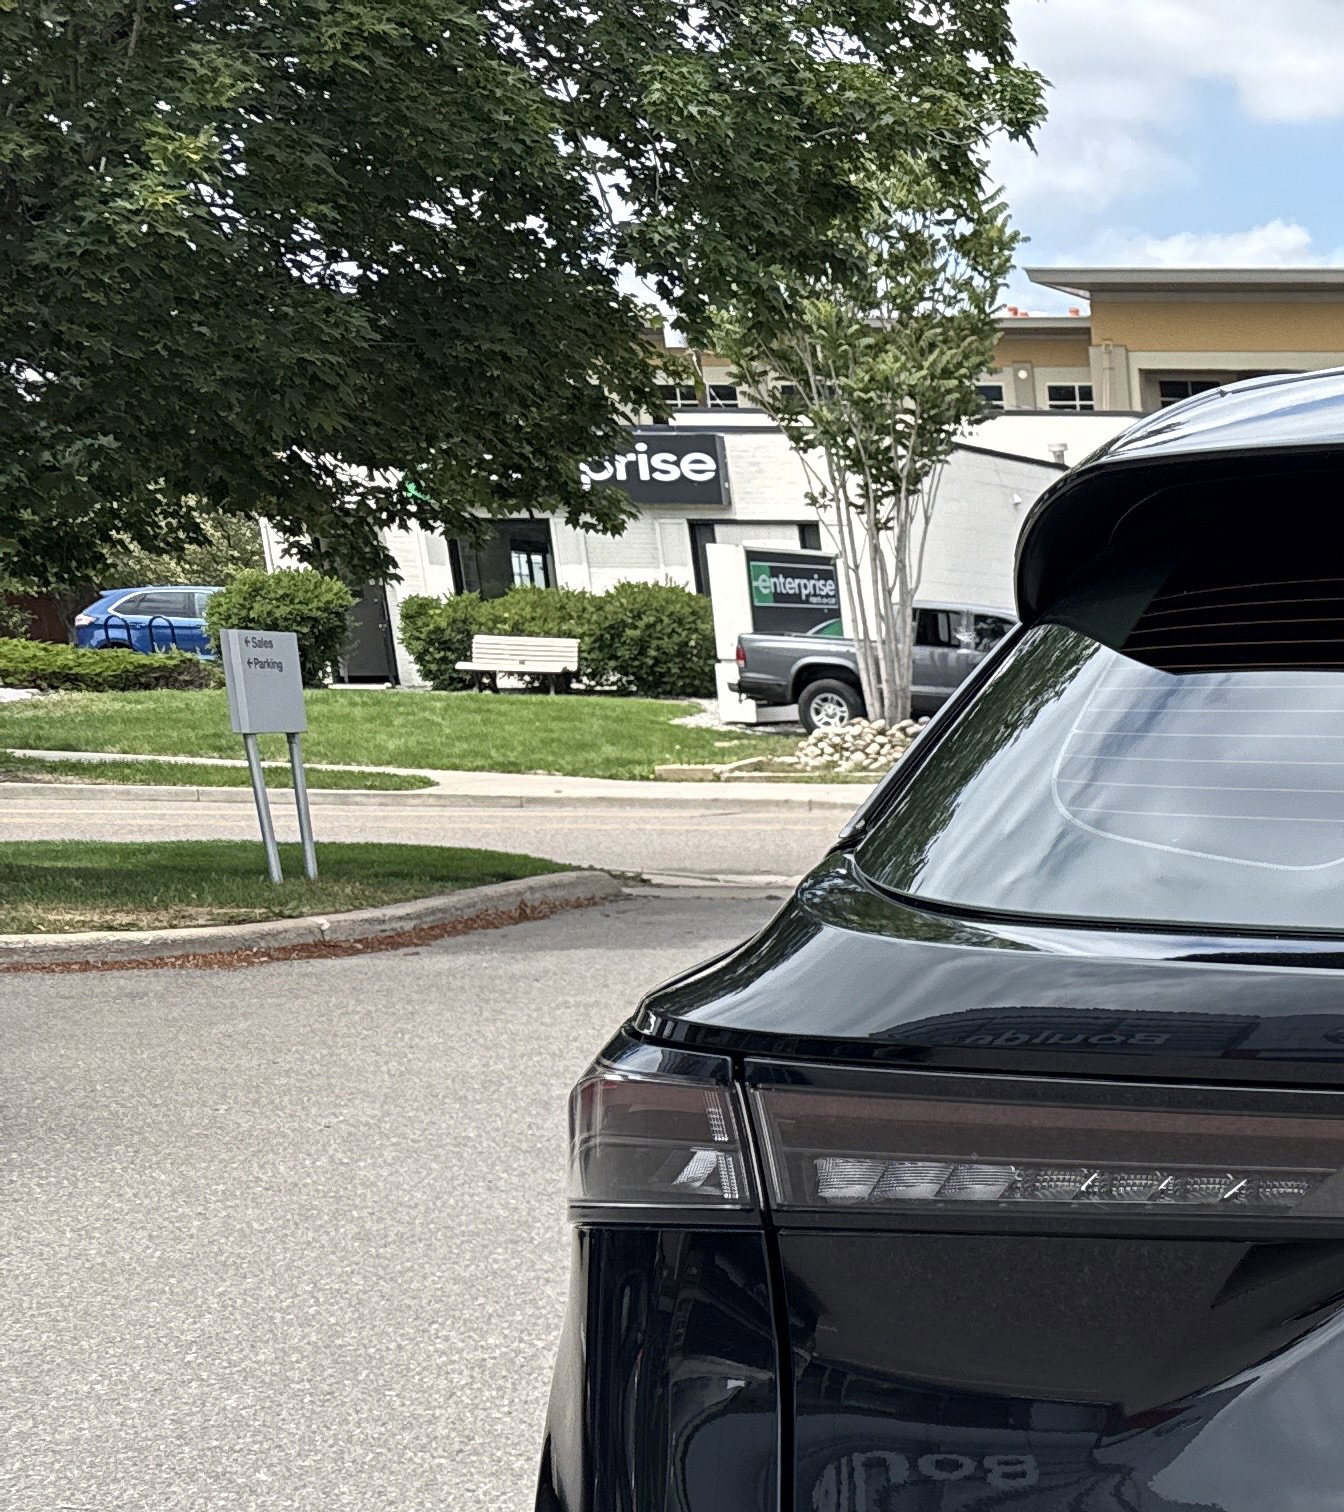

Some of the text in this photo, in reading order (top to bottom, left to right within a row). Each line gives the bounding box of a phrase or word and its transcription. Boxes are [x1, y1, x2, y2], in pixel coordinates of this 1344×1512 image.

[578, 442, 717, 490] prise
[753, 574, 836, 600] enterprise
[252, 637, 274, 649] Sales
[254, 658, 284, 672] Parking
